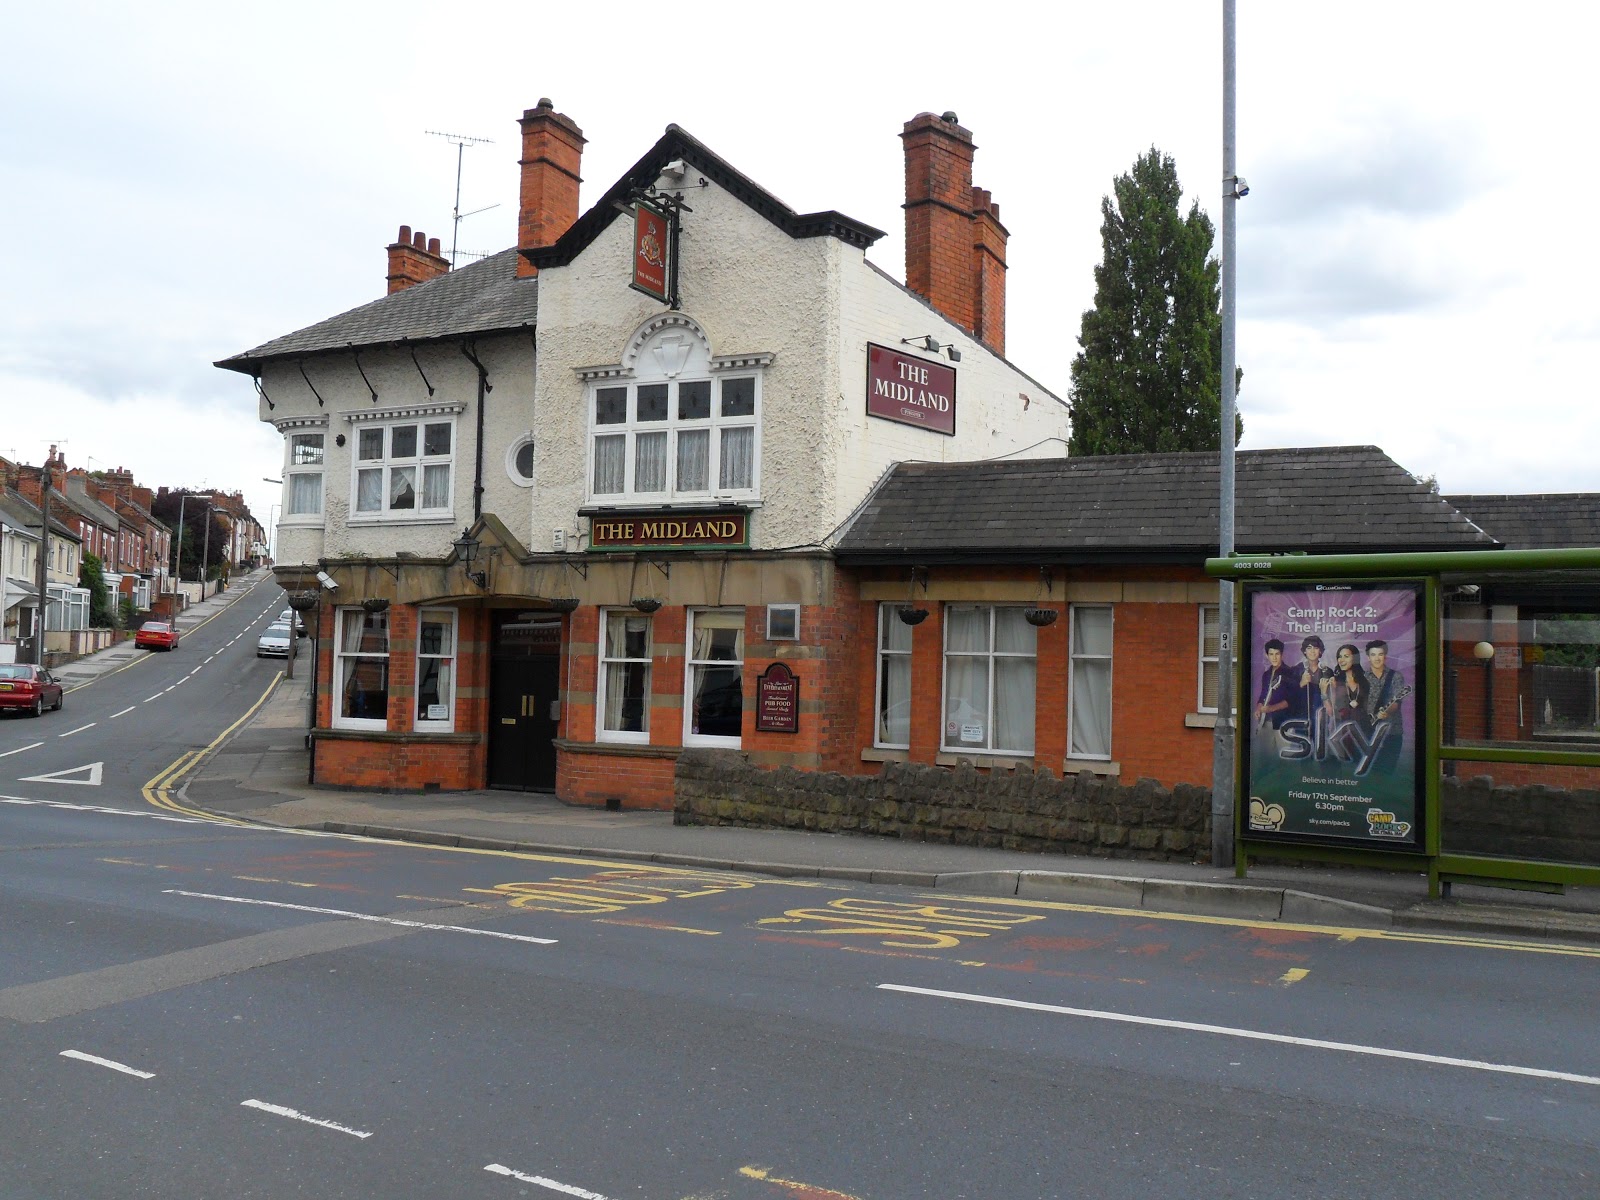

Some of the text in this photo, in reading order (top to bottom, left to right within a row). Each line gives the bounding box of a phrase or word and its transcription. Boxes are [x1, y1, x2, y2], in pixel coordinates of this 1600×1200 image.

[898, 361, 929, 386] THE
[874, 378, 949, 412] MIDLAND
[596, 521, 737, 540] THE MIDLAND
[1287, 606, 1377, 619] Camp Rock 2:
[1286, 621, 1378, 633] The Final Jam
[1278, 705, 1391, 777] sky
[1301, 776, 1327, 784] Believe
[1335, 777, 1359, 786] better
[1288, 790, 1373, 803] Friday 17th September
[1315, 802, 1344, 812] 6.30pm
[1309, 818, 1351, 827] sky.com/packs
[1368, 814, 1393, 824] CAMP
[462, 870, 756, 914] STOP
[745, 897, 1047, 949] BUS
